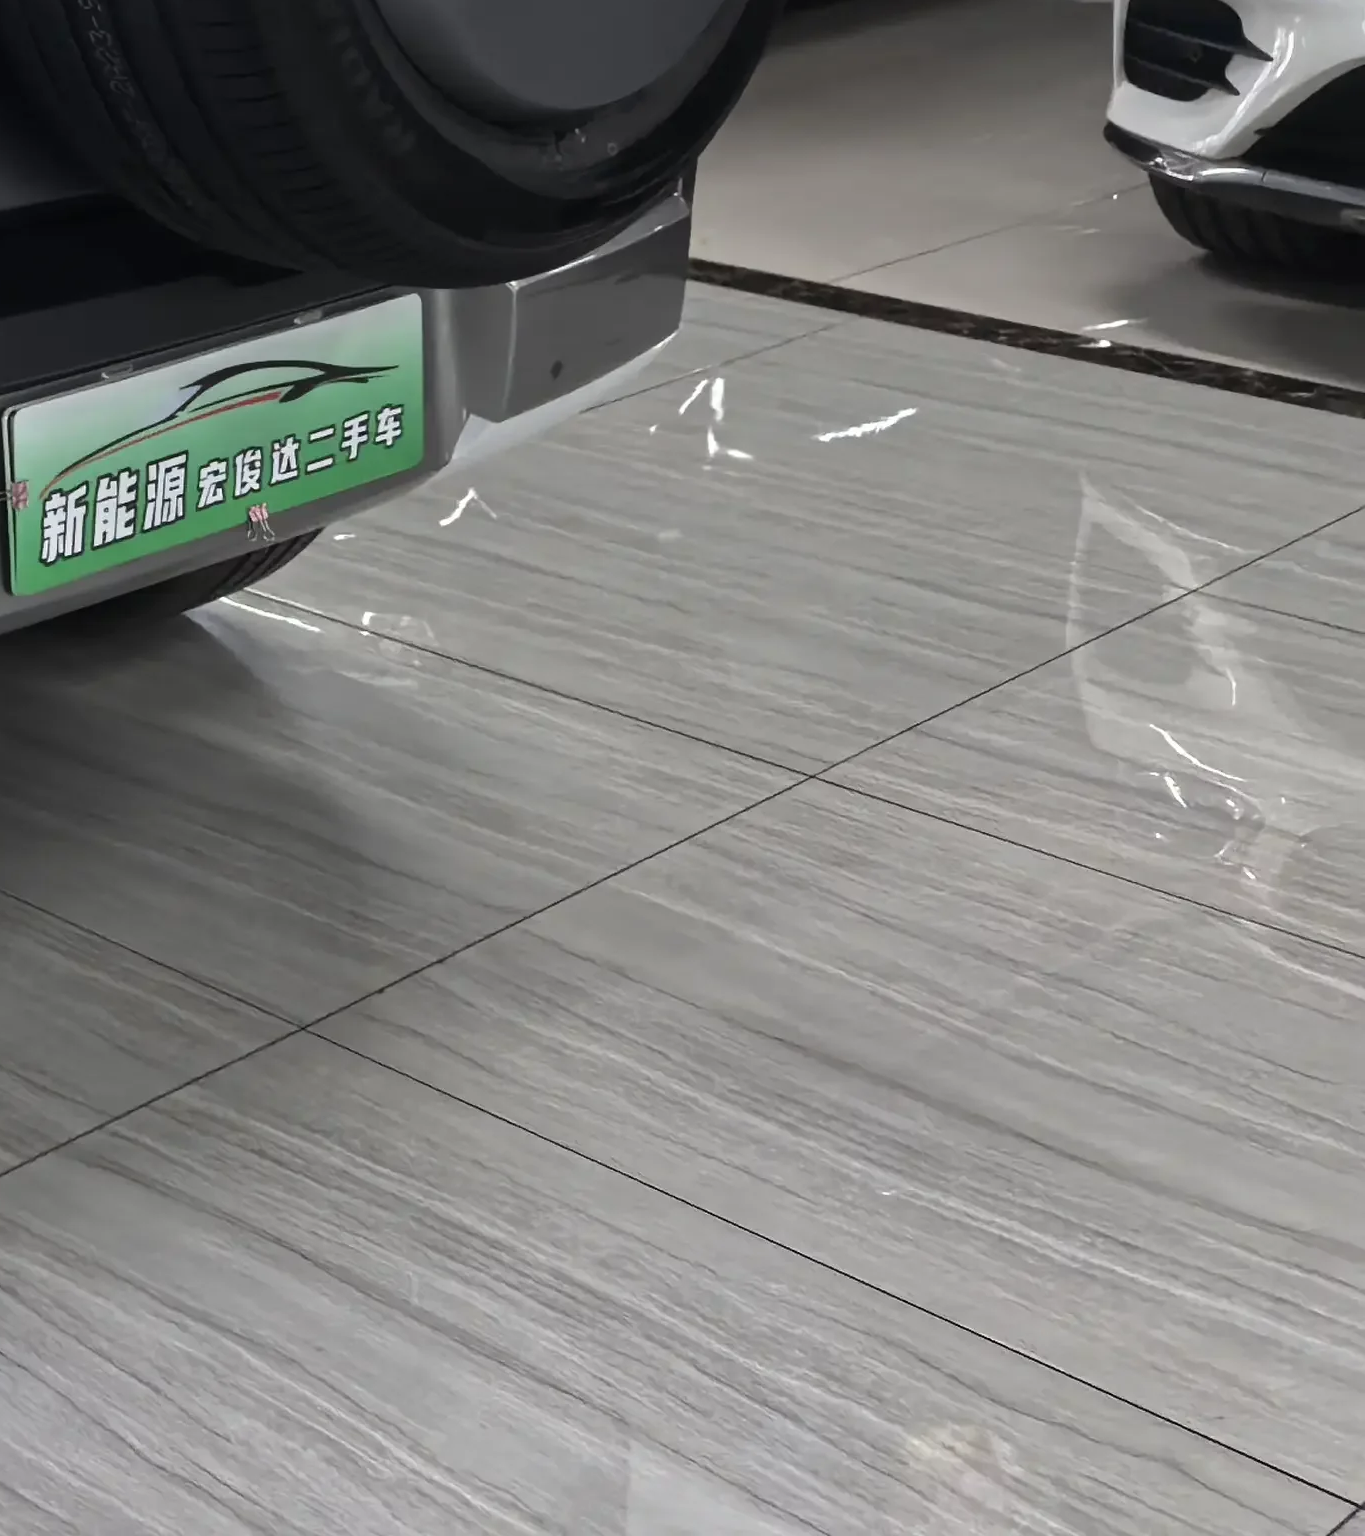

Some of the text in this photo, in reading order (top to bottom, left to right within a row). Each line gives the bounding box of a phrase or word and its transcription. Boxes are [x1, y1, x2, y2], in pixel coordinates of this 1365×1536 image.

[39, 403, 404, 564] 新能源 宏俊达二手车
